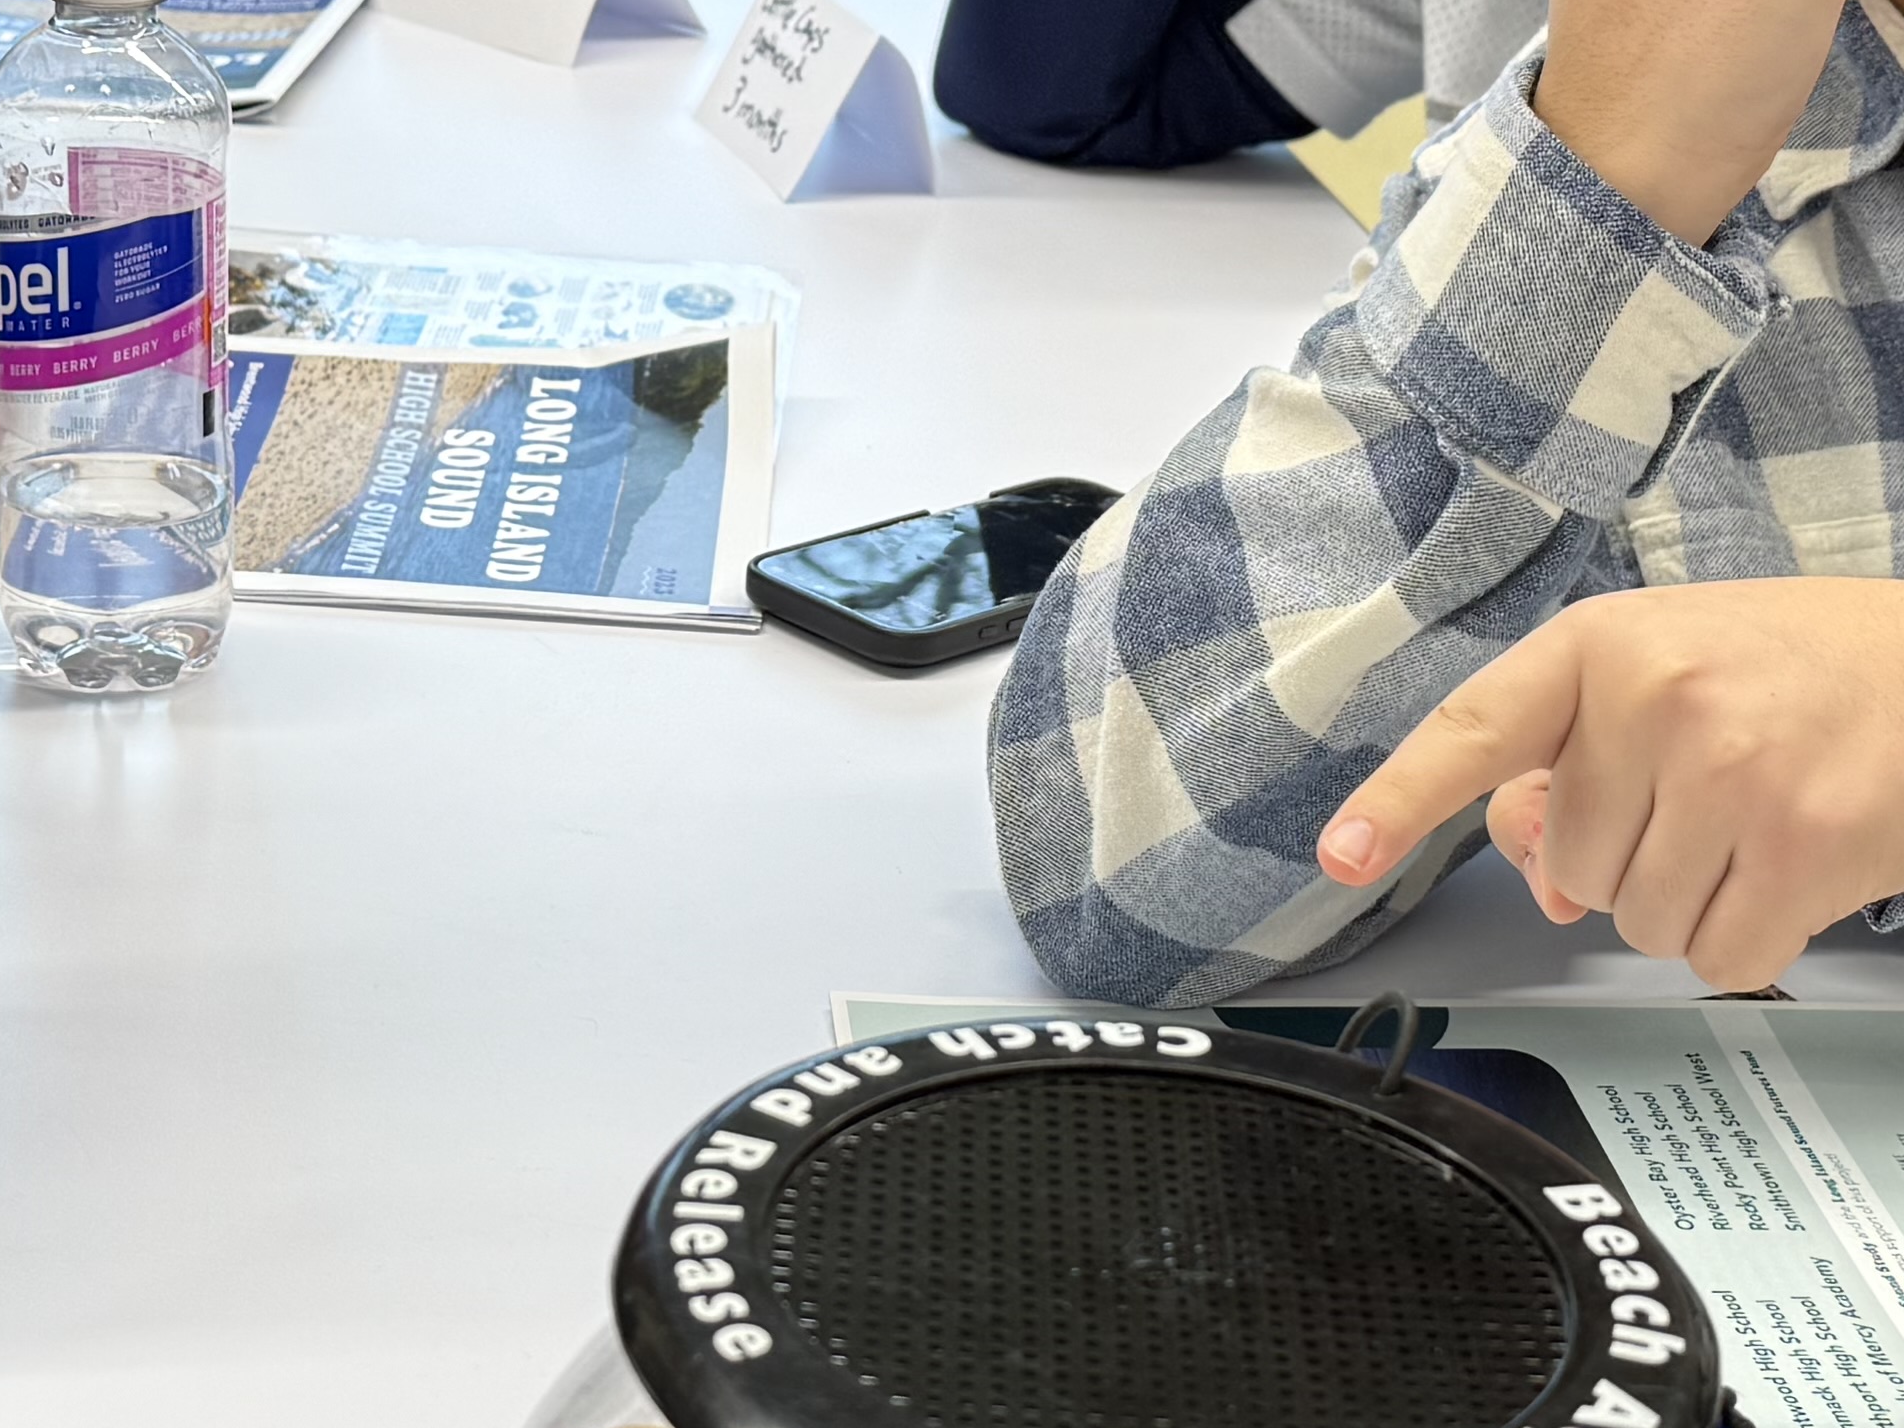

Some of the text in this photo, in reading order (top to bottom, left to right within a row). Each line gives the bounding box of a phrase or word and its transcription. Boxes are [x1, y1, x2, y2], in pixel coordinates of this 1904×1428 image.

[5, 316, 70, 332] WATER
[53, 356, 98, 375] BERRY
[113, 338, 159, 363] BERRY
[340, 370, 438, 575] HIGH SCHOOL SUMMIT
[419, 428, 496, 529] SOUND
[485, 376, 582, 583] LONG ISLAND
[1739, 1049, 1764, 1075] Fund
[1758, 1076, 1788, 1114] Futures
[1684, 1052, 1806, 1232] Smithtown High School West
[1779, 1114, 1809, 1146] Sound
[1596, 1085, 1696, 1231] Oyster Bay High School
[1633, 1091, 1733, 1231] Riverhead High School
[1664, 1083, 1770, 1231] Rocky Point High School
[1800, 1147, 1829, 1177] Island
[669, 1020, 1212, 1363] Catch and Release
[1822, 1178, 1846, 1203] Long
[1542, 1182, 1687, 1366] Beach
[1862, 1241, 1891, 1273] Study
[1809, 1255, 1861, 1319] Academy
[1711, 1289, 1757, 1335] School
[1756, 1299, 1802, 1345] School
[1790, 1295, 1837, 1341] School
[1743, 1338, 1780, 1372] High
[1788, 1348, 1825, 1382] High
[1824, 1344, 1862, 1378] High
[1852, 1322, 1893, 1367] Mercy
[1875, 1369, 1904, 1385] of
